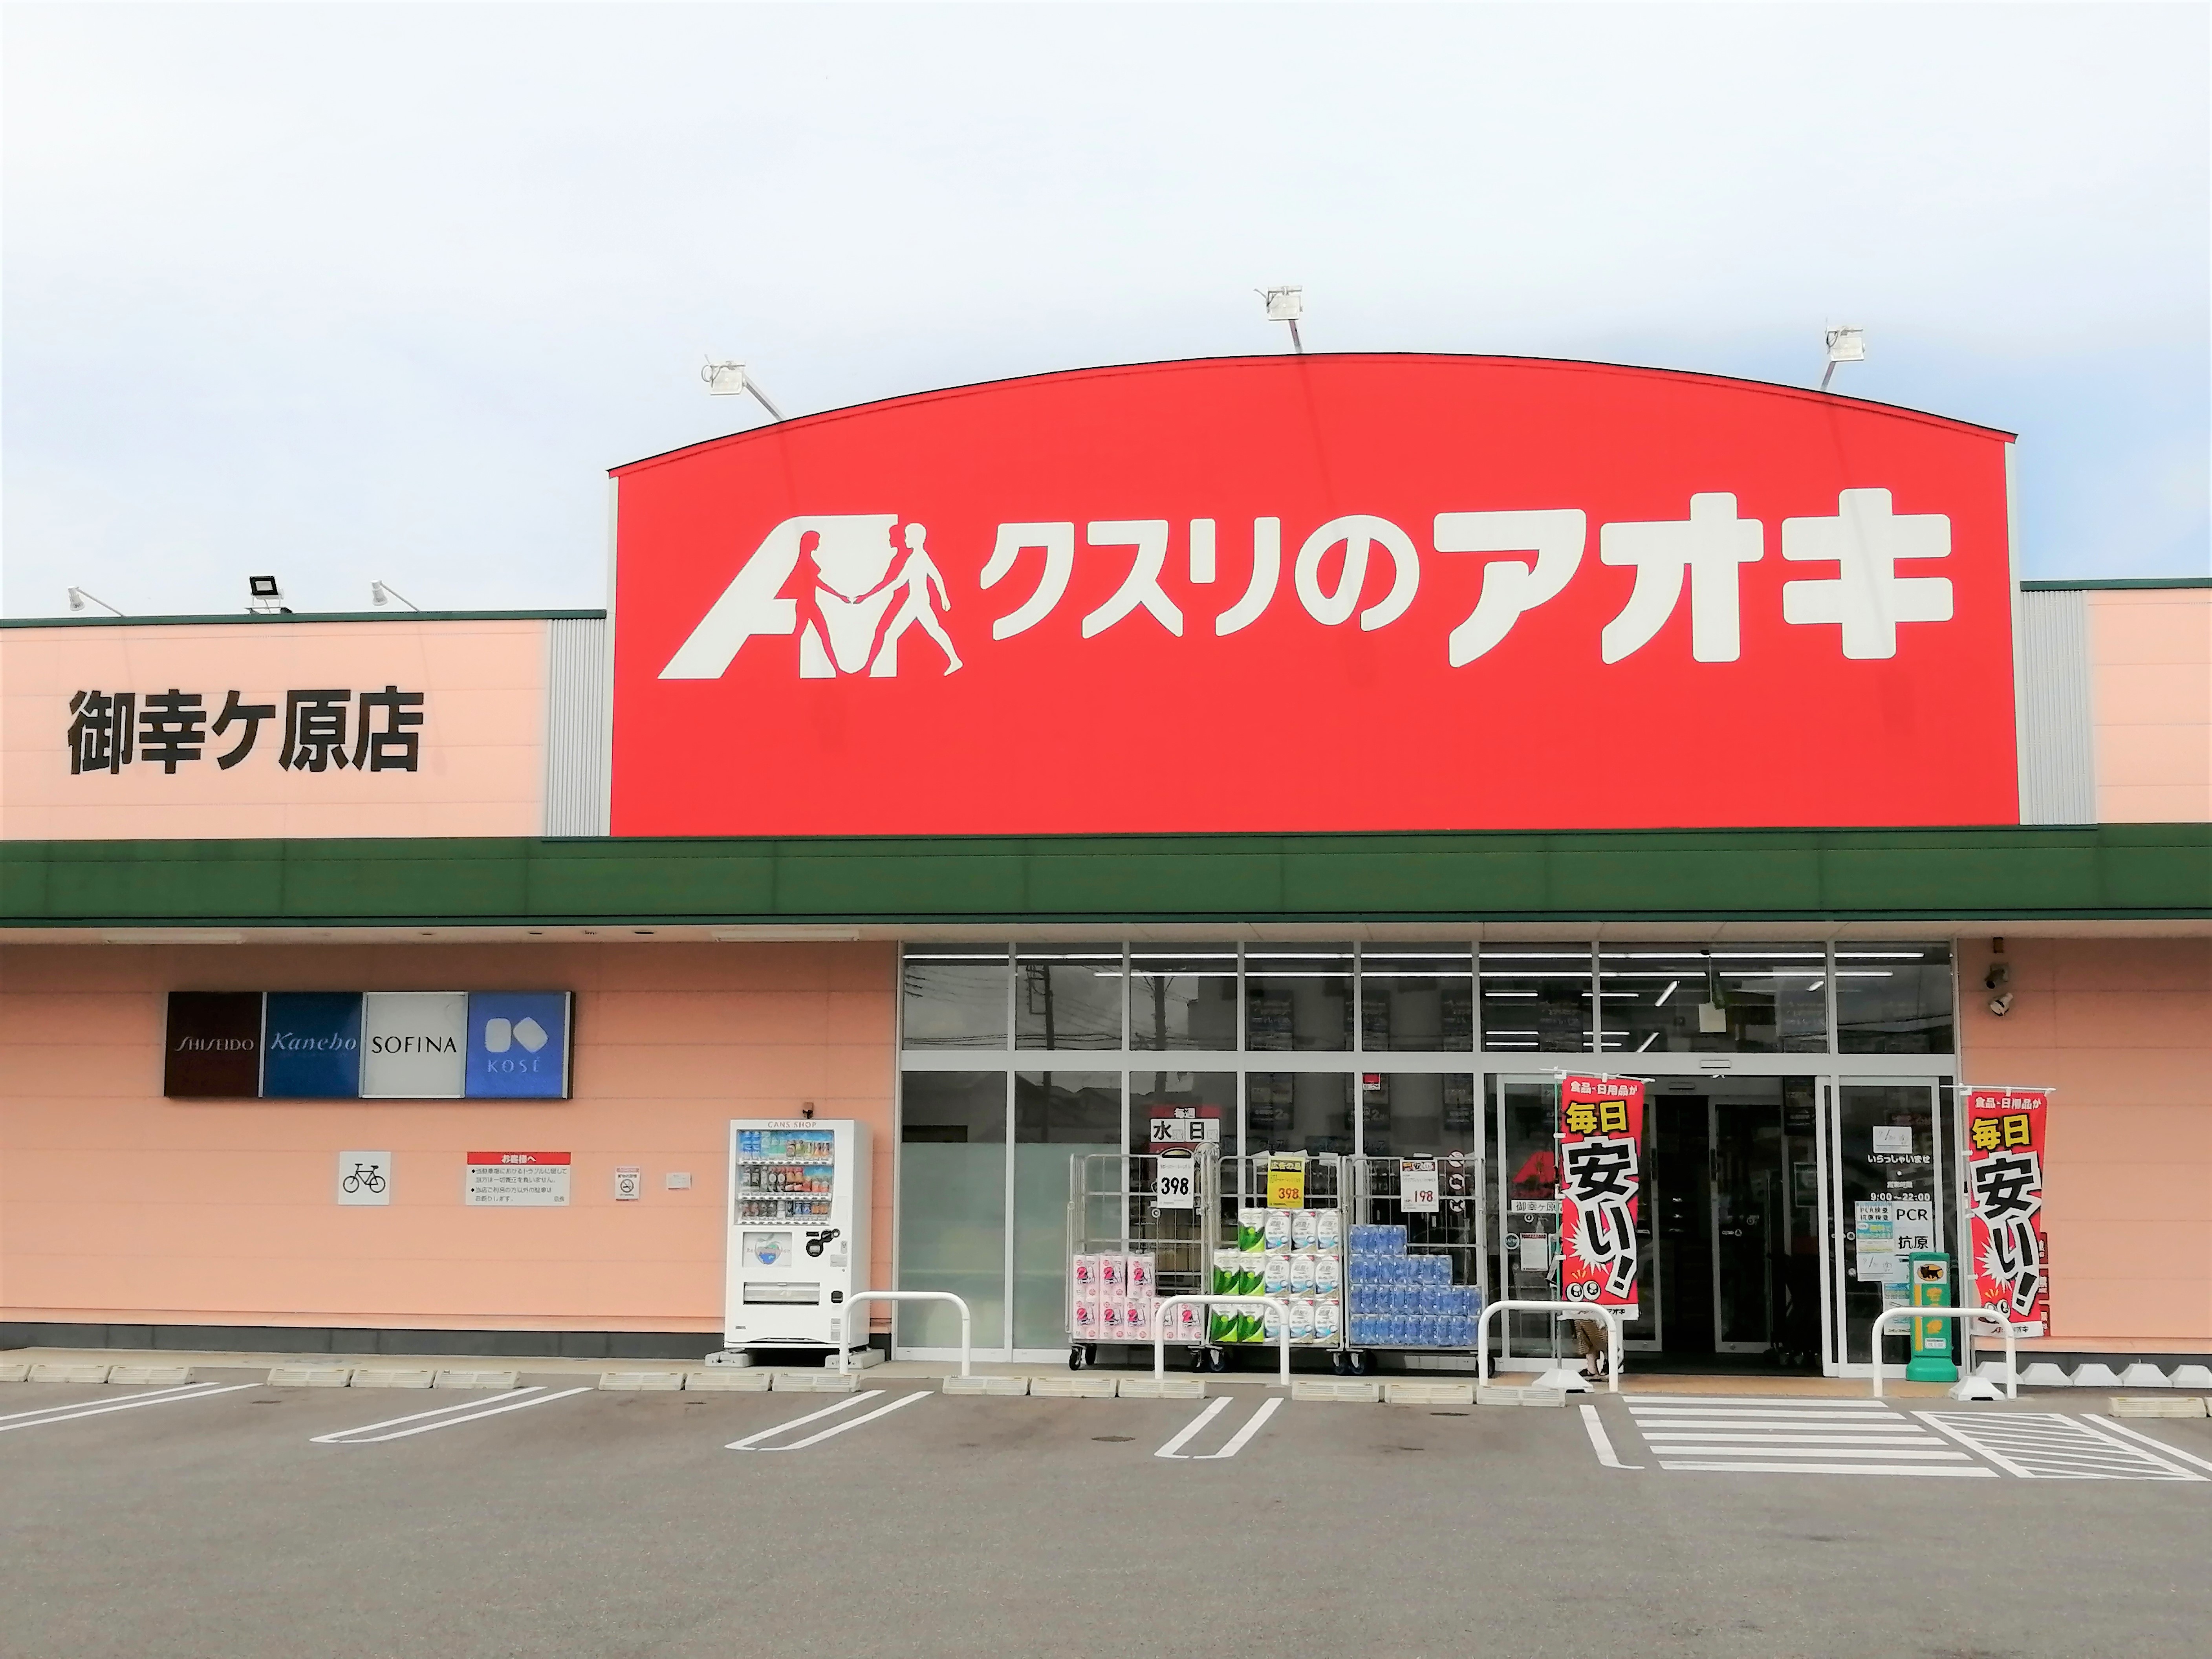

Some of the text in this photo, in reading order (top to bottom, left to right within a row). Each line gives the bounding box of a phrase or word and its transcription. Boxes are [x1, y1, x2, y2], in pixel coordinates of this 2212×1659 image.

[980, 487, 1954, 668] クスリのアオキ
[175, 1036, 255, 1051] SHISEIDO
[271, 1032, 357, 1051] Kanebo
[372, 1036, 457, 1054] SOFINA
[487, 1057, 540, 1073] KOSÉ
[1571, 1081, 1638, 1097] 食品・日用品が
[1976, 1097, 2041, 1110] 食品・日用品が
[1566, 1101, 1627, 1134] 毎日
[1972, 1114, 2029, 1150] 毎日
[501, 1154, 537, 1165] お客様へ
[1868, 1154, 1930, 1164] いらっしゃいませ
[1161, 1177, 1188, 1195] 398
[1278, 1187, 1299, 1199] 398
[1414, 1190, 1433, 1202] 198
[1897, 1209, 1928, 1221] PCR
[1898, 1236, 1929, 1249] 抗原
